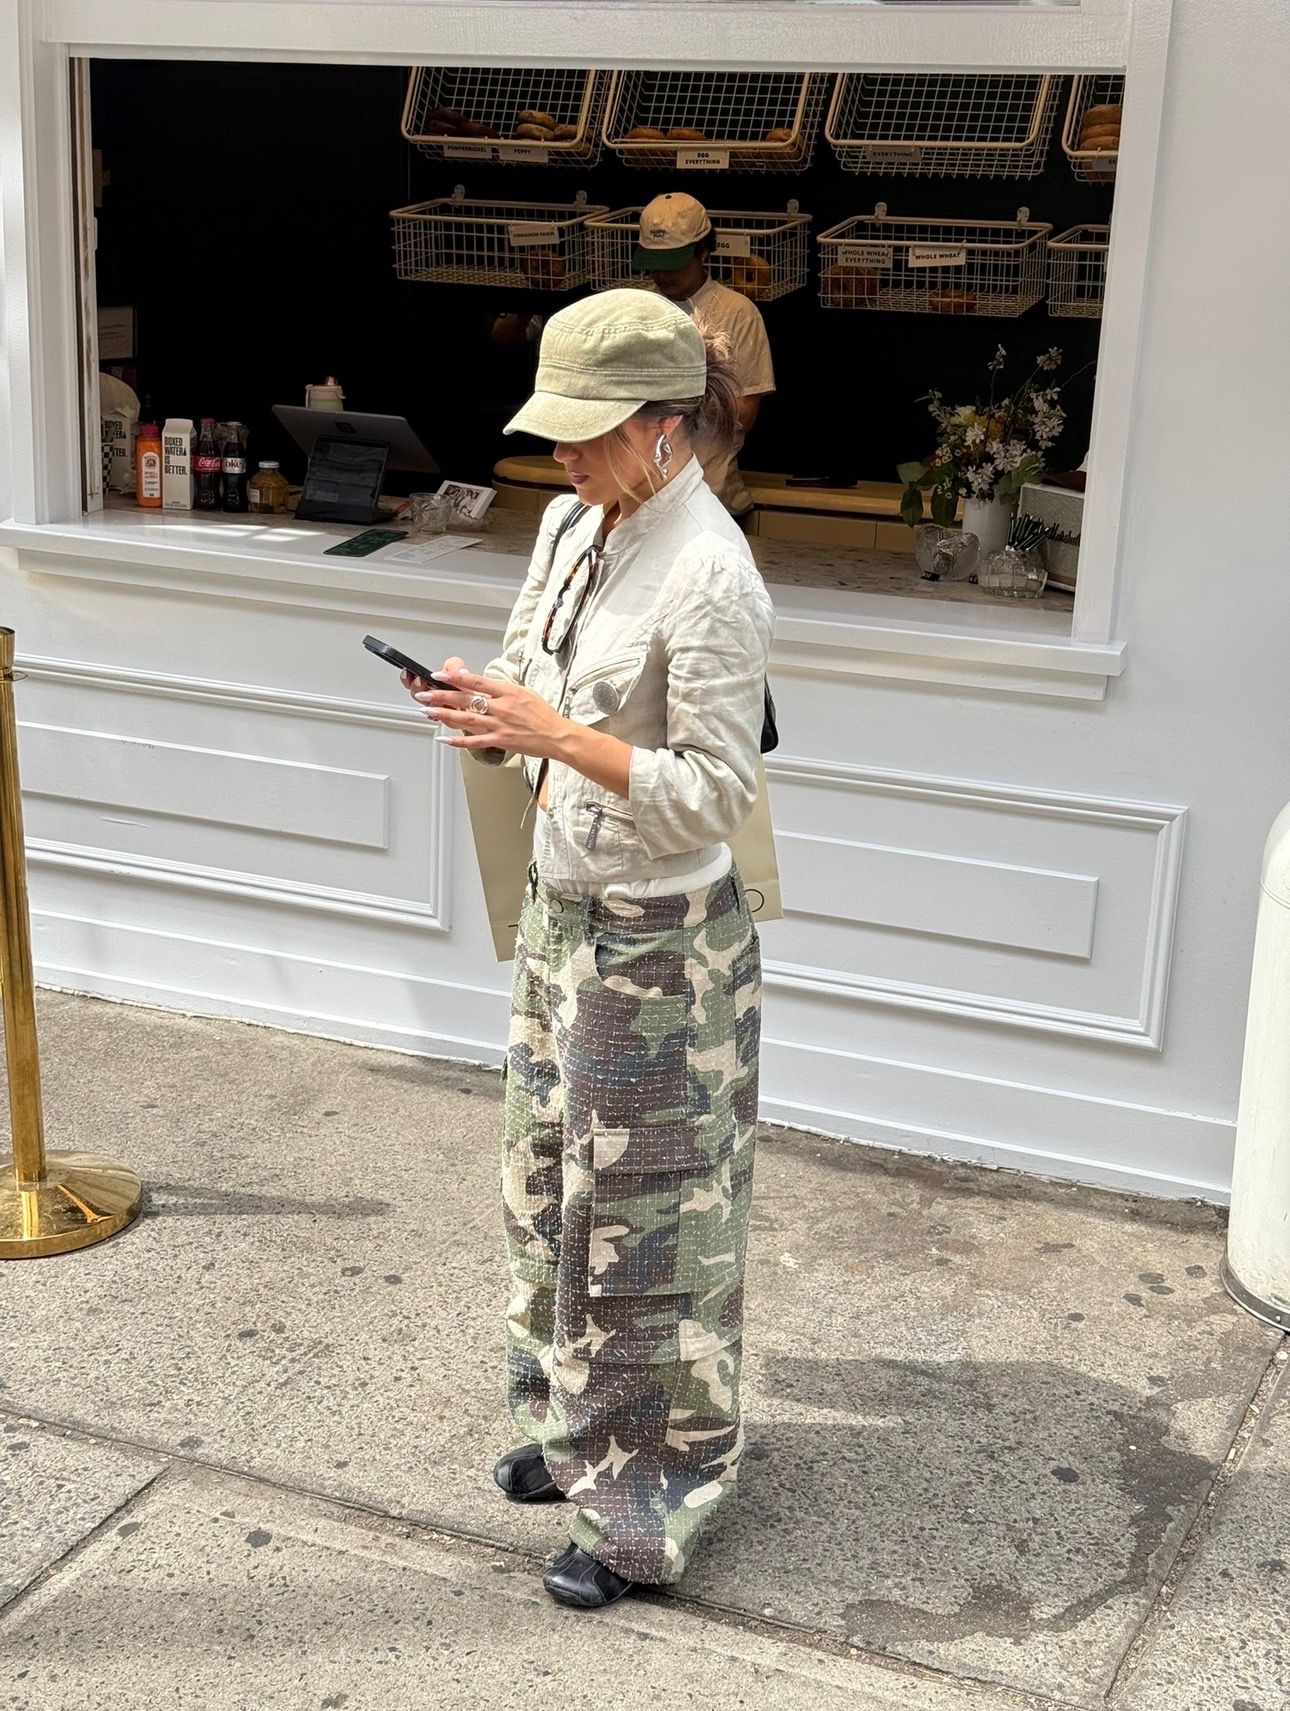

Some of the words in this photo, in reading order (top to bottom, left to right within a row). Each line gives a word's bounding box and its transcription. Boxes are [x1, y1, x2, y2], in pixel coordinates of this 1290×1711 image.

[447, 145, 489, 153] PUMPERNICKEL
[845, 257, 886, 265] EVERYTHING
[164, 436, 183, 447] BOXED
[164, 446, 184, 456] WATER
[164, 455, 171, 465] IS
[164, 464, 188, 475] BETTER.
